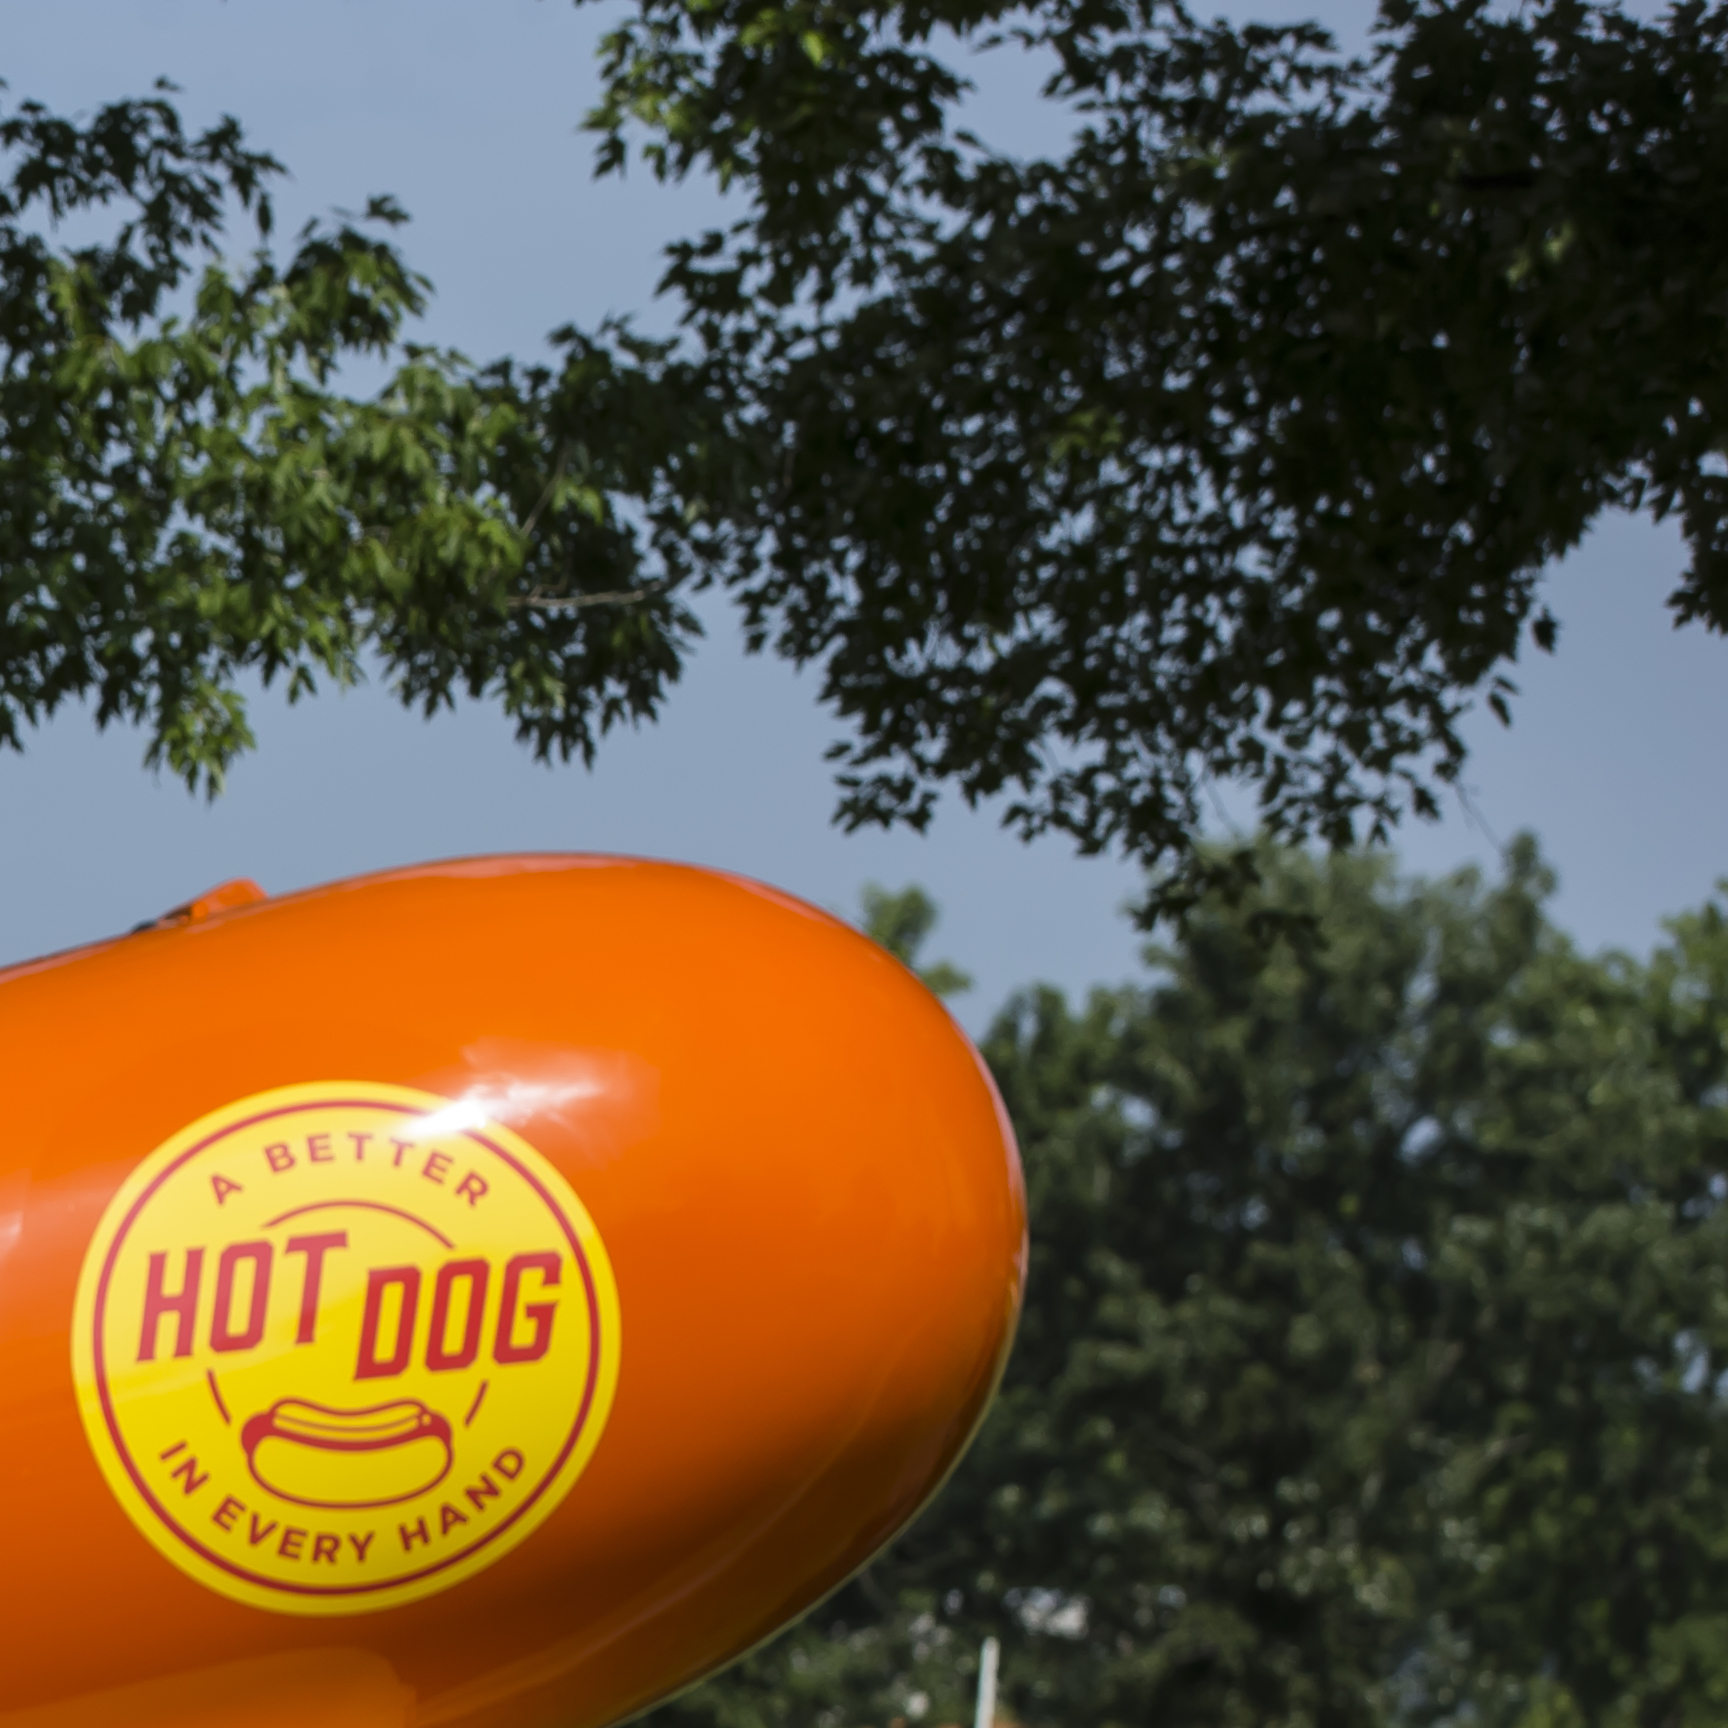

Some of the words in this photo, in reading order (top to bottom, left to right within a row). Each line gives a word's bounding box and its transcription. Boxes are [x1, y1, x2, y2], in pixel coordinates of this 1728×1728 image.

[209, 1172, 244, 1206] A
[263, 1131, 490, 1208] BETTER
[134, 1228, 350, 1365] HOT
[352, 1249, 564, 1383] DOG
[158, 1439, 211, 1497] IN
[210, 1493, 376, 1566] EVERY
[397, 1445, 528, 1553] HAND
